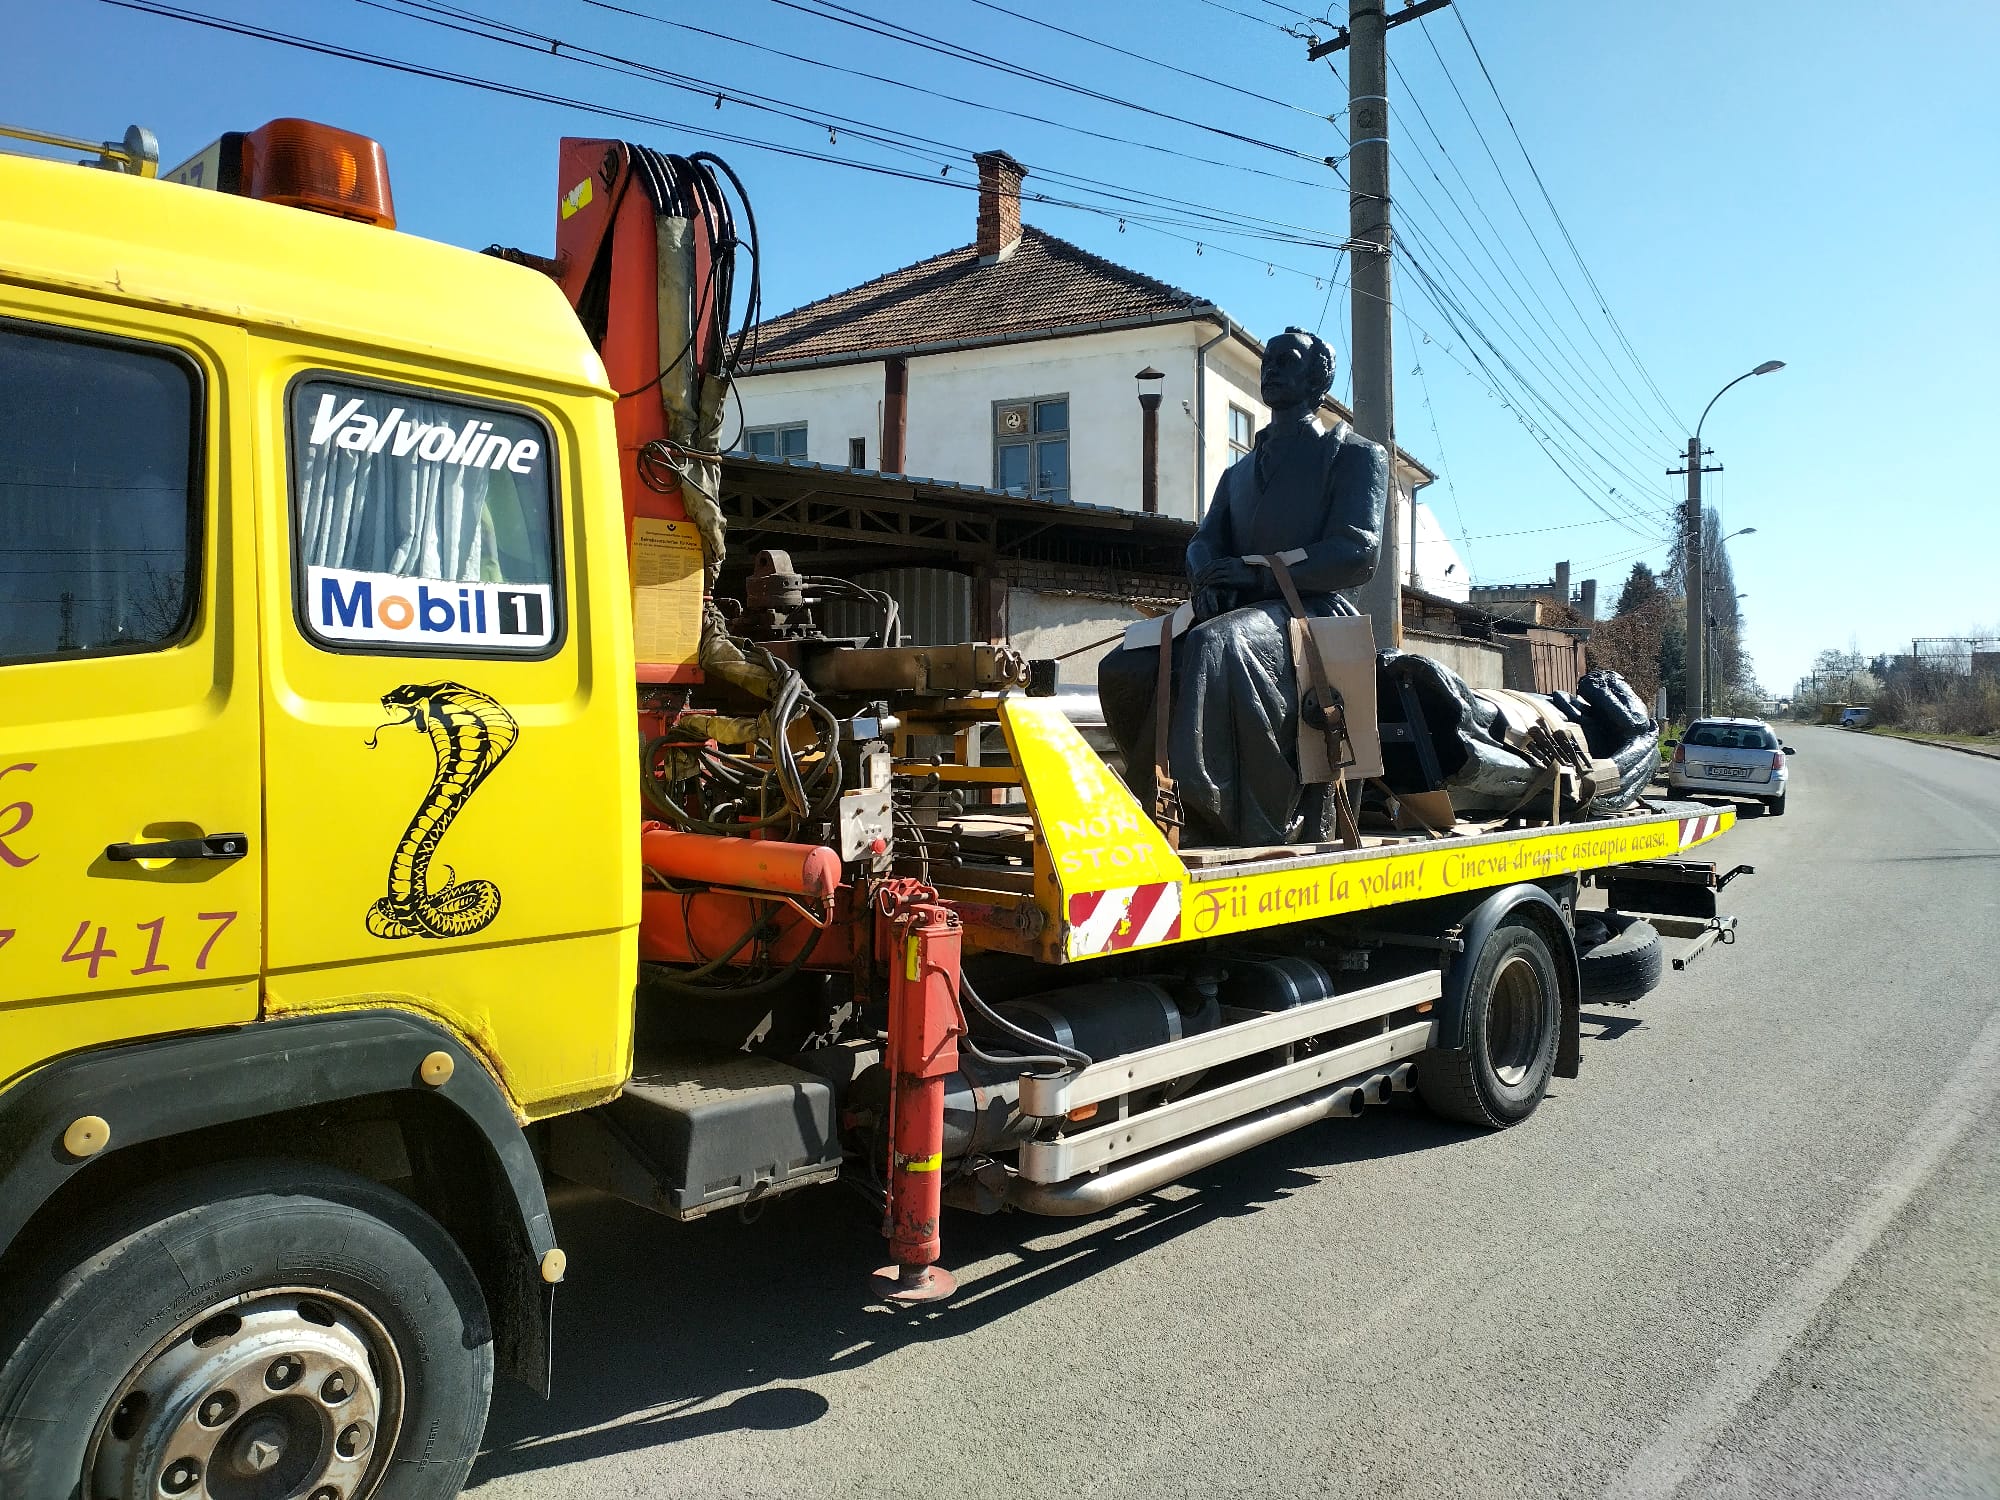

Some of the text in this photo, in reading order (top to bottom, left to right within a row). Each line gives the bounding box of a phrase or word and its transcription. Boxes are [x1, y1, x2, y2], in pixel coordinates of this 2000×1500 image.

[309, 393, 540, 475] Valvoline
[321, 577, 528, 634] Mobil 1
[1057, 814, 1140, 842] NON
[1193, 884, 1248, 934] Fii
[1258, 880, 1320, 914] atent
[1329, 870, 1350, 902] la
[1358, 859, 1425, 893] volan!
[1442, 852, 1507, 888] Cineva
[1572, 836, 1627, 864] asteapta
[61, 911, 238, 979] 417
